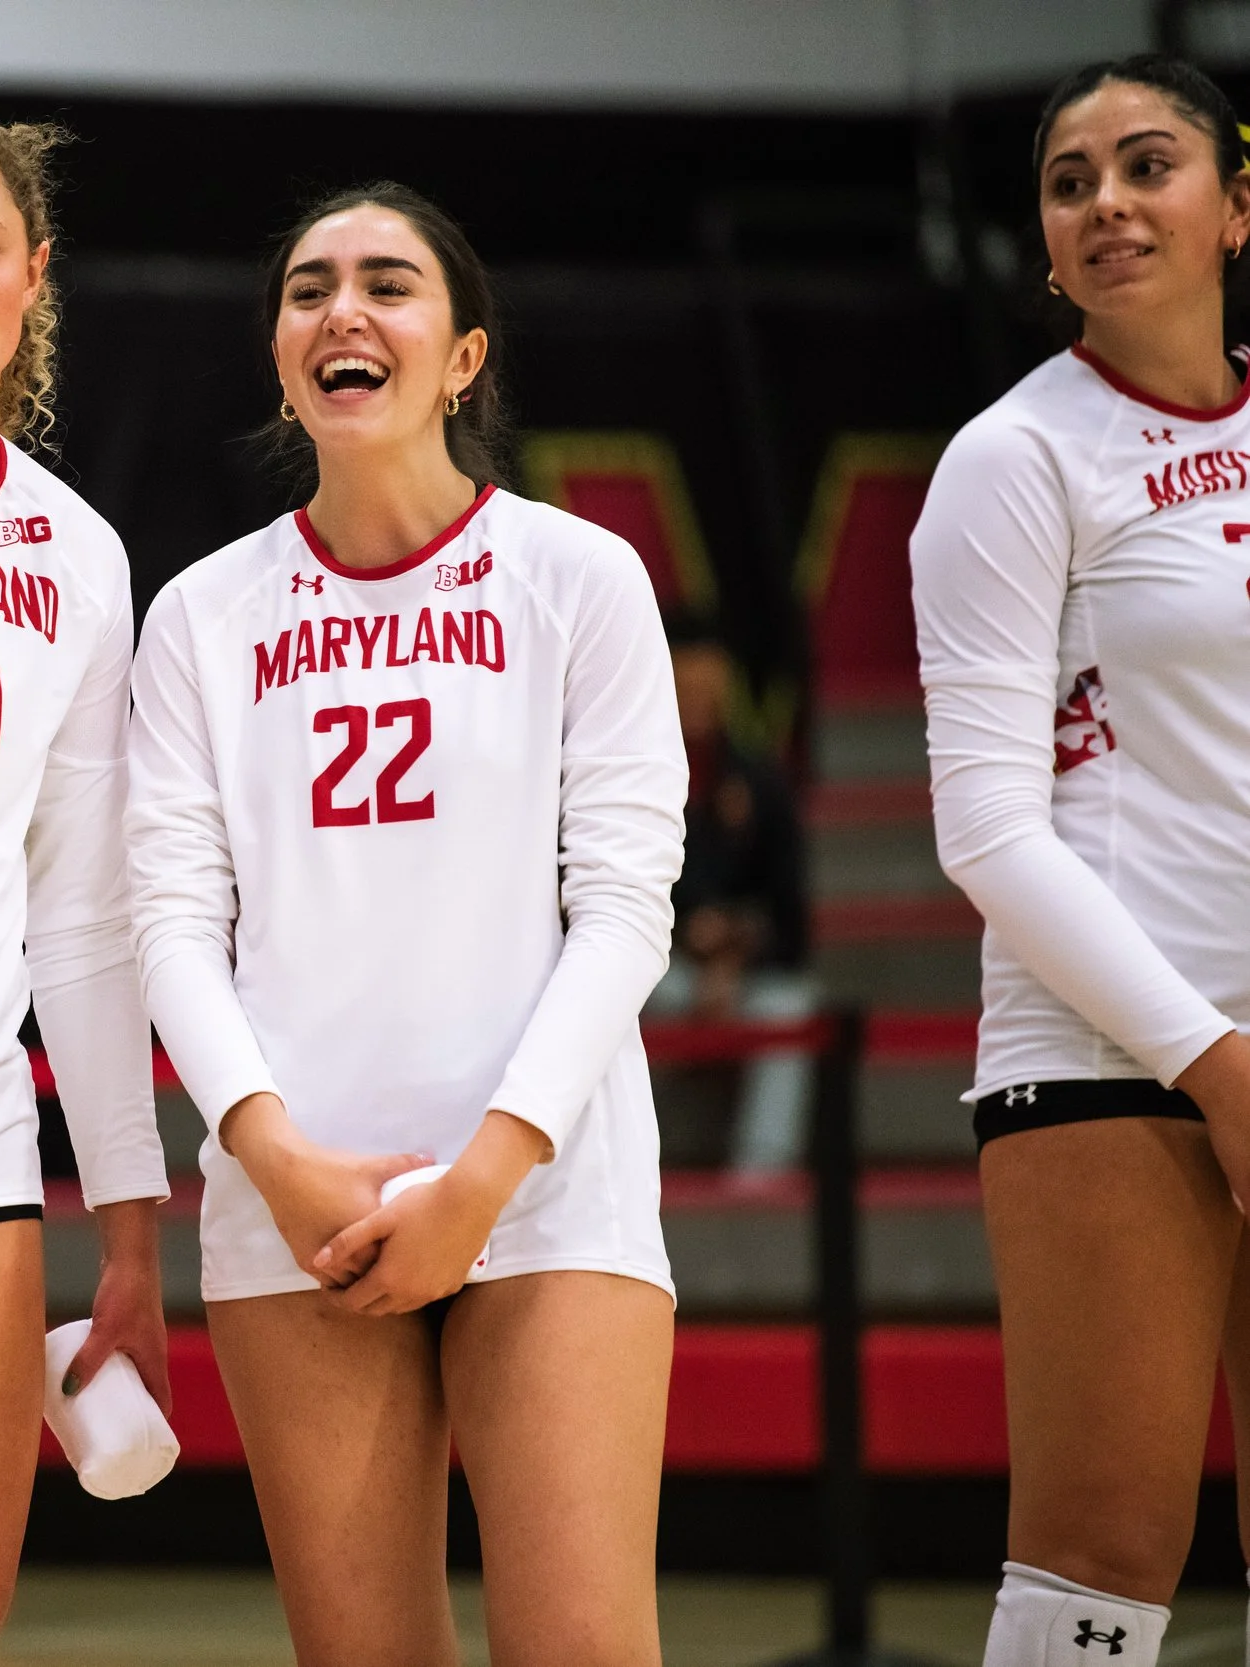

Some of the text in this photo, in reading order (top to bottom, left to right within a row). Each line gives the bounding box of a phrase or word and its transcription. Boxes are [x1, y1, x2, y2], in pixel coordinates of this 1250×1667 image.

[1144, 450, 1250, 512] MARY
[254, 607, 506, 706] MARYLAND
[311, 697, 435, 828] 22
